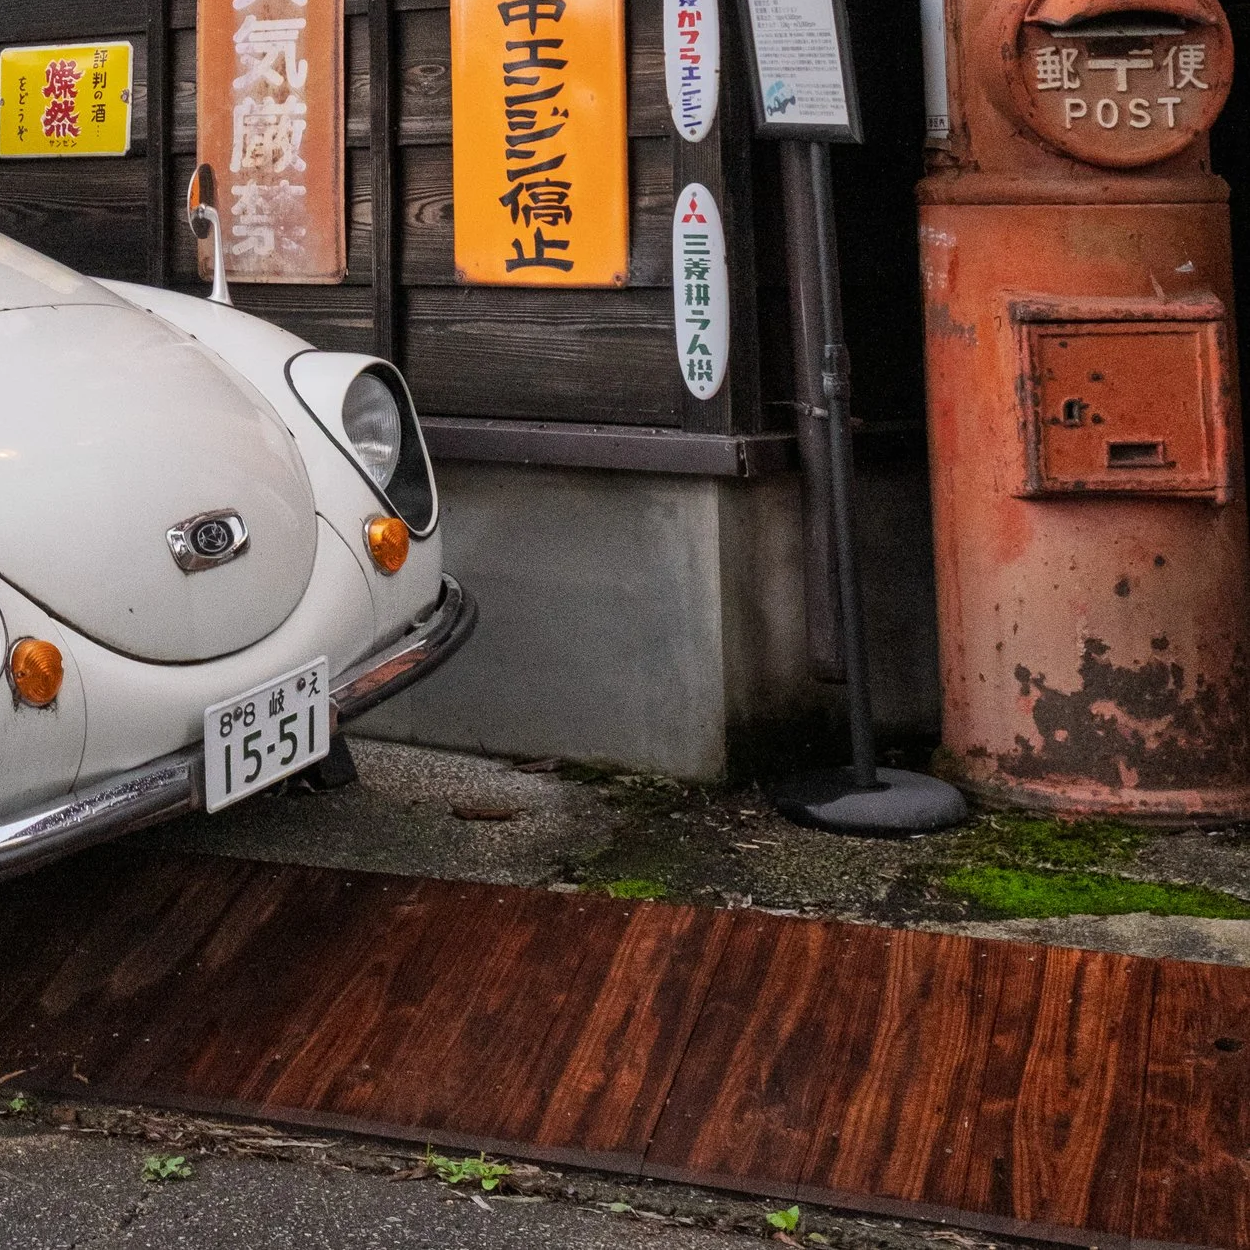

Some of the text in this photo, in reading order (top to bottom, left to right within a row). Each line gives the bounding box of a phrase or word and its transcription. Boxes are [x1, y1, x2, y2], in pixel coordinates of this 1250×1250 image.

[17, 76, 28, 142] をどうぞ
[1065, 97, 1182, 130] POST
[681, 234, 714, 383] 三菱耕うん機
[268, 688, 285, 719] 岐
[224, 704, 315, 795] 15-51
